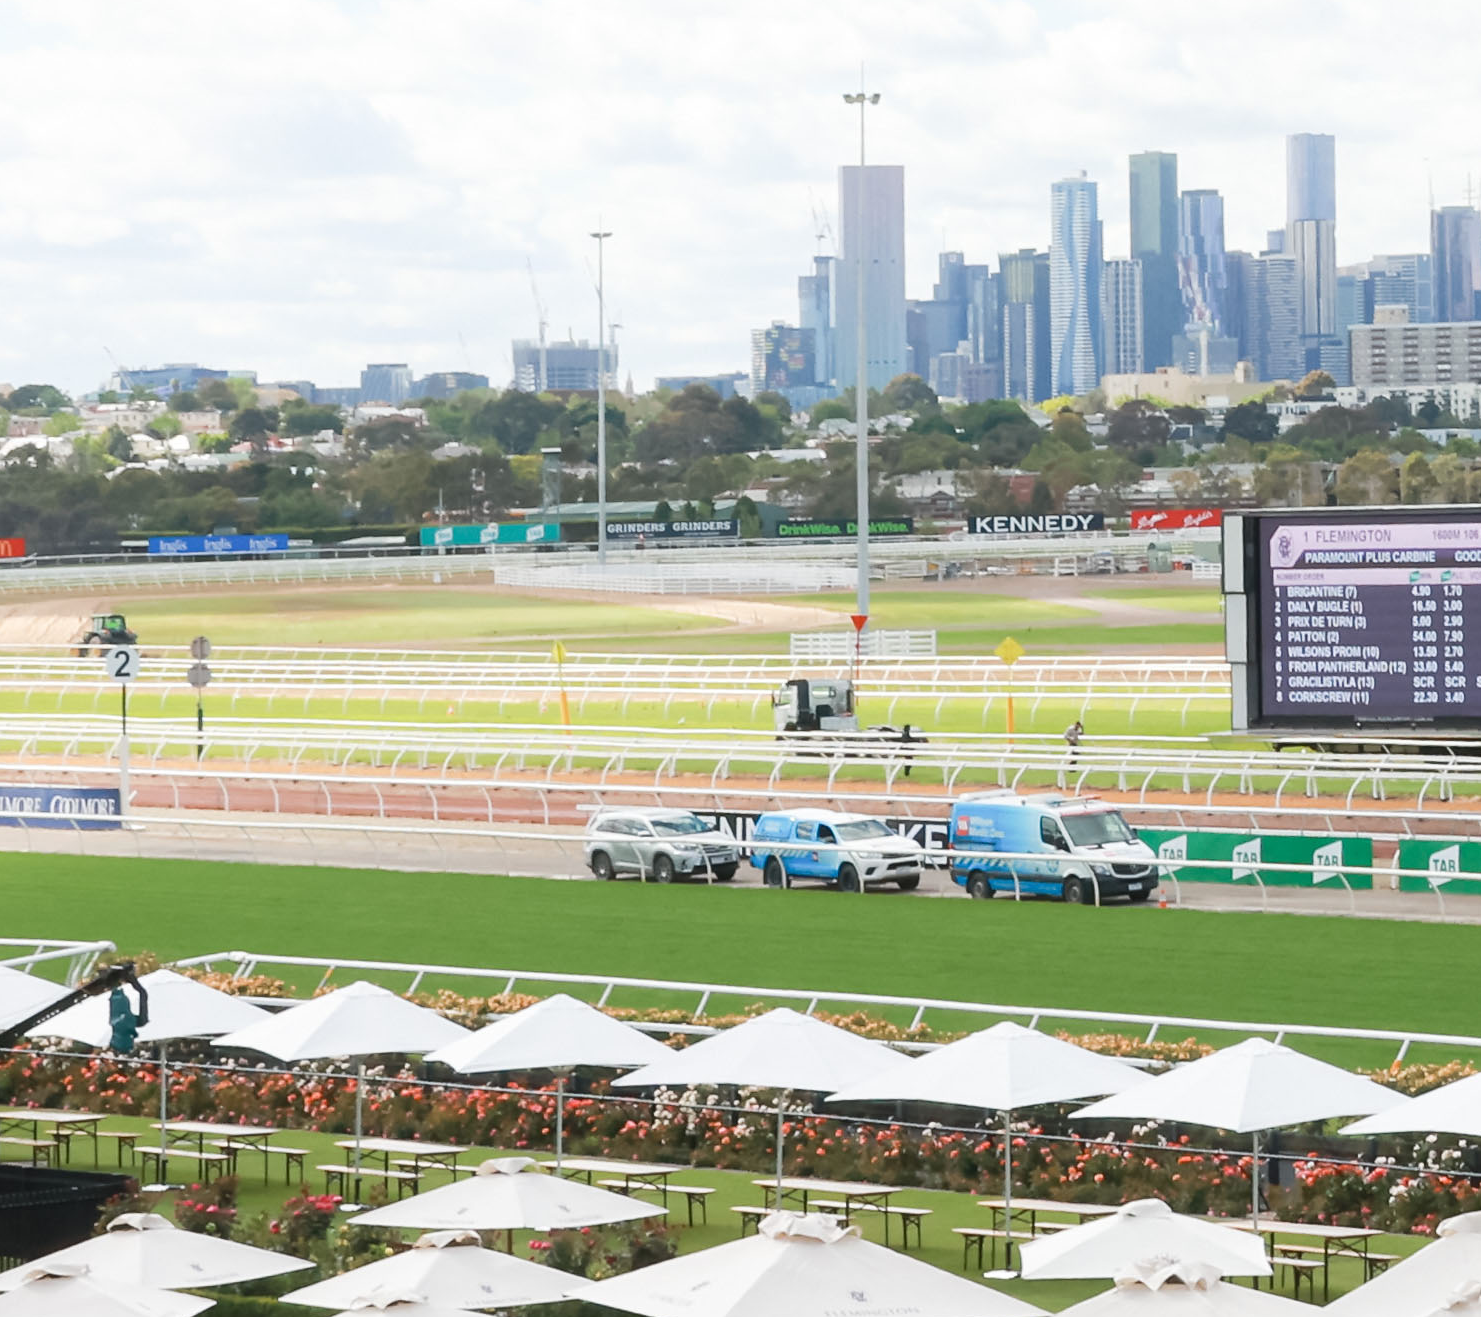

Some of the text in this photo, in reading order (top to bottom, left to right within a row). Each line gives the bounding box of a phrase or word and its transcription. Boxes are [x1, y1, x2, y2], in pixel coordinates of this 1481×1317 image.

[607, 523, 665, 534] GRINDERS
[672, 521, 732, 532] GRINDERS
[976, 515, 1094, 533] KENNEDY
[1316, 530, 1391, 542] FLEMINGTON
[1305, 552, 1364, 563] PARAMOUNT
[1366, 551, 1391, 563] PLUS
[1275, 587, 1280, 597] 1
[1287, 586, 1344, 597] BRIGANTINE
[1275, 602, 1281, 613] 2
[1288, 601, 1316, 612] DAILY
[1318, 601, 1349, 612] BUGLE
[1350, 601, 1363, 614] (1)
[1275, 616, 1281, 627] 3
[1288, 616, 1310, 627] PRIX
[1311, 616, 1325, 627] DE
[1326, 616, 1354, 627] TURN
[1275, 631, 1281, 642] 4
[1288, 631, 1326, 642] PATTON
[1327, 631, 1339, 644] (2)
[1288, 646, 1331, 657] WILSONS
[1333, 646, 1361, 657] PROM
[1362, 646, 1380, 659] (10)
[115, 651, 131, 677] 2
[1289, 661, 1317, 672] FROM
[1318, 661, 1388, 672] PANTHERLAND
[1389, 661, 1407, 675] (12)
[1276, 676, 1282, 687] 7
[1288, 676, 1356, 687] GRACILISTYLA
[1357, 676, 1375, 689] (13)
[1413, 676, 1435, 687] SCR
[1445, 676, 1466, 687] SCR
[1289, 691, 1351, 702] CORKSCREW
[1352, 691, 1370, 705] (11)
[1163, 849, 1183, 861] TAB
[1236, 852, 1258, 863] TAB
[1317, 855, 1338, 867] TAB
[1432, 859, 1457, 874] TAB
